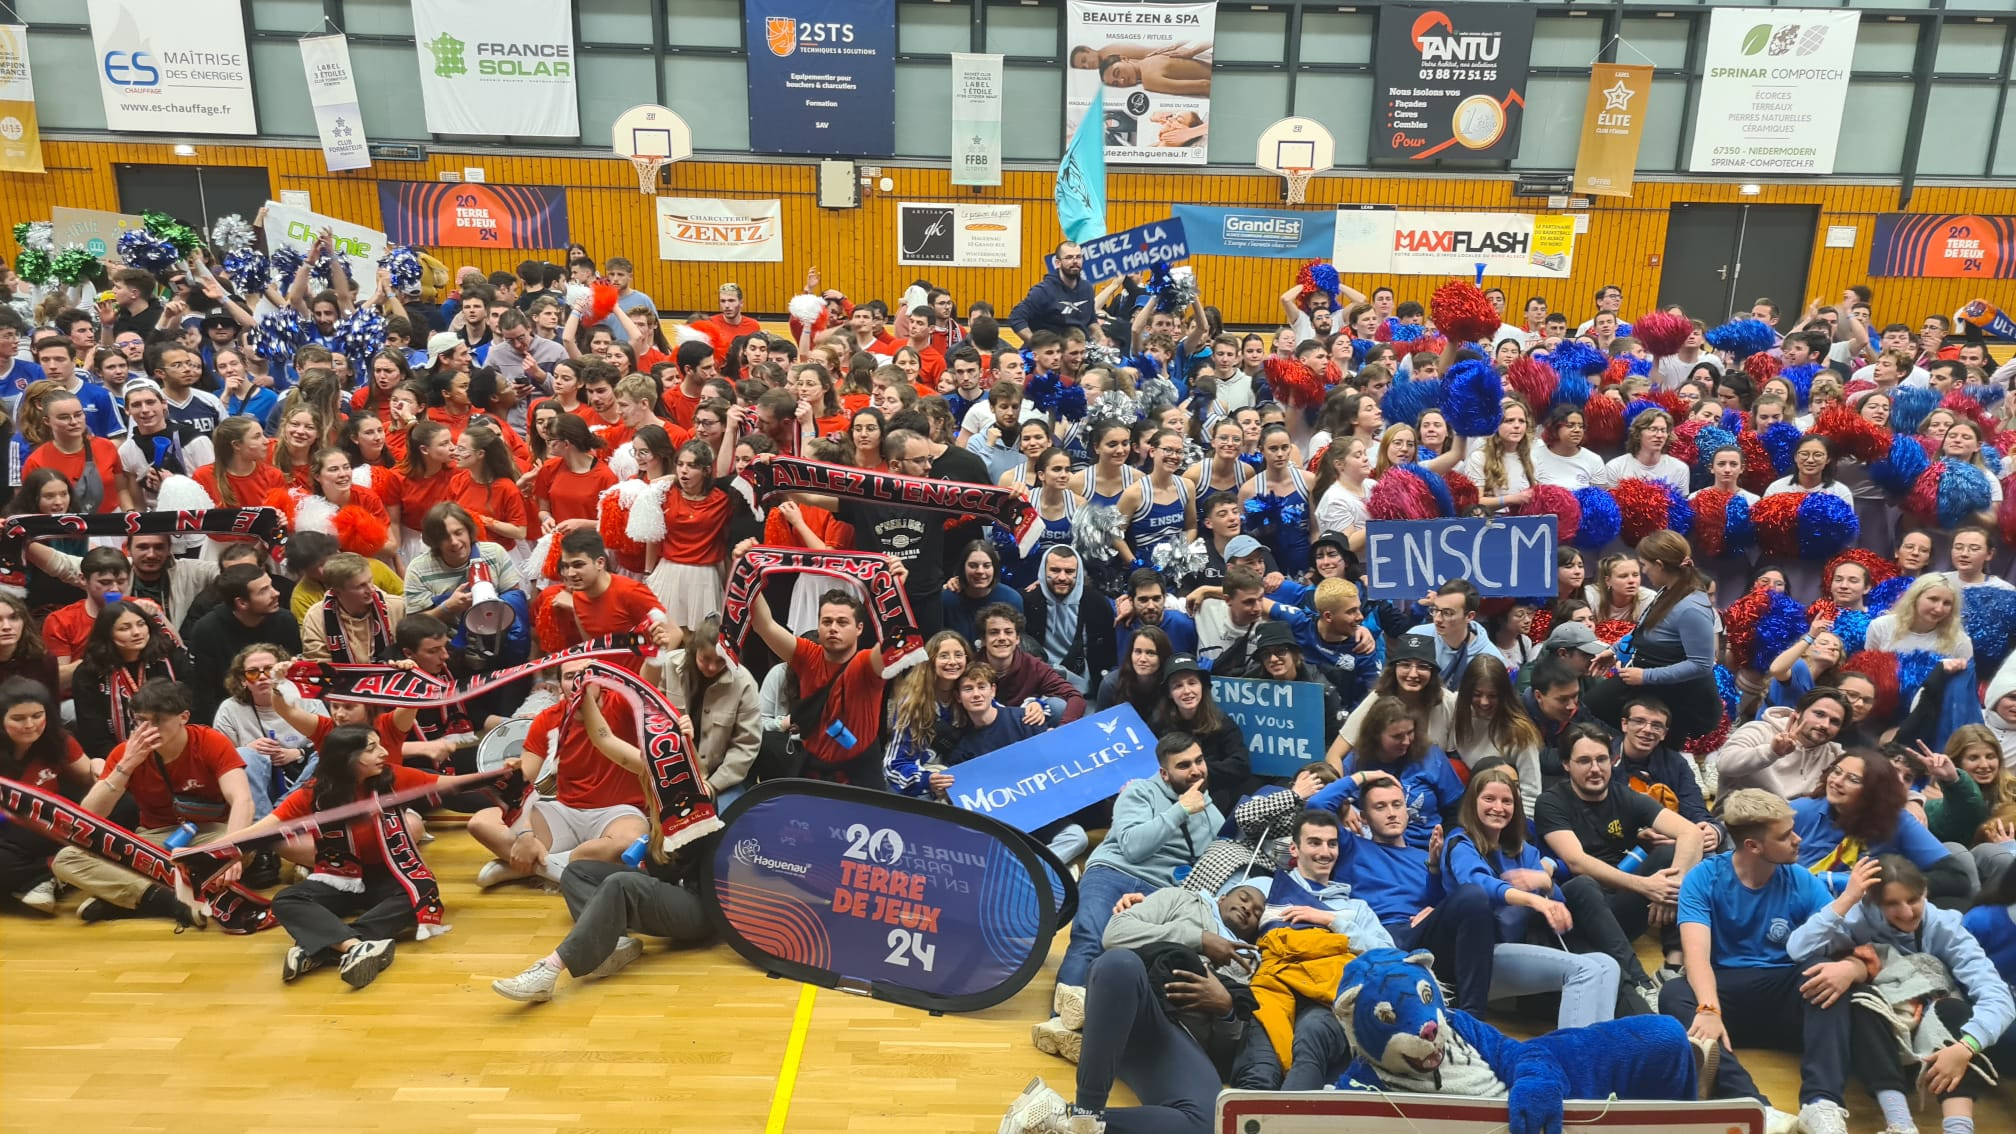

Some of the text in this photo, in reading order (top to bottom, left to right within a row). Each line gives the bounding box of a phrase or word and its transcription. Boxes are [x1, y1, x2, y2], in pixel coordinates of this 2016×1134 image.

[1082, 11, 1199, 25] BEAUTÉ ZEN & SPA
[800, 23, 854, 42] 2STS
[1147, 33, 1173, 41] RITUELS
[477, 43, 569, 57] FRANCE
[1417, 37, 1501, 60] TANTU
[164, 50, 241, 67] MAÎTRISE
[166, 69, 243, 81] DES ÉNERGIES
[479, 60, 570, 76] SOLAR
[1420, 69, 1497, 80] 03 88 72 51 55
[1710, 68, 1843, 80] SPRINAR COMPOTECH
[125, 87, 162, 95] CHAUFFAGE
[1389, 88, 1411, 96] Nous
[1413, 88, 1445, 96] isolons
[1755, 89, 1791, 100] ÉCORCES
[120, 102, 232, 116] www.es-chauffage.fr
[1395, 100, 1427, 109] Façades
[1751, 102, 1792, 111] TERREAUX
[1598, 110, 1631, 126] ÉLITE
[1728, 113, 1811, 122] PIERRES NATURELLES
[1742, 123, 1794, 133] CÉRAMIQUES
[1392, 132, 1426, 149] Pour
[1103, 149, 1188, 158] utezenhaguenau.fr
[1713, 146, 1741, 155] 67350
[1748, 147, 1816, 156] NIEDERMODERN
[965, 155, 988, 165] FFBB
[1711, 158, 1815, 168] SPRINAR-COMPOTECH.FR
[455, 195, 477, 207] 20
[456, 208, 489, 219] TERRE
[456, 218, 496, 229] DE JEUX
[479, 228, 497, 241] 24
[677, 223, 762, 241] ZENTZ
[1144, 226, 1167, 243] LA
[1949, 226, 1971, 238] 20
[288, 221, 371, 258] Chmie
[1946, 239, 1980, 249] TERRE
[1944, 248, 1984, 258] DE JEUX
[1091, 242, 1186, 279] LA MAISON
[1963, 259, 1982, 271] 24
[1993, 316, 2016, 339] ULT
[772, 462, 866, 496] ALLEZ
[1151, 512, 1184, 527] ENSCM
[1369, 523, 1551, 588] ENSCM
[1210, 680, 1293, 708] ENSCM
[1249, 733, 1312, 760] AIME
[843, 824, 904, 865] 20
[753, 855, 807, 874] Haguenau
[840, 860, 926, 901] TERRE
[832, 888, 942, 933] DE JEUX
[884, 929, 935, 972] 24
